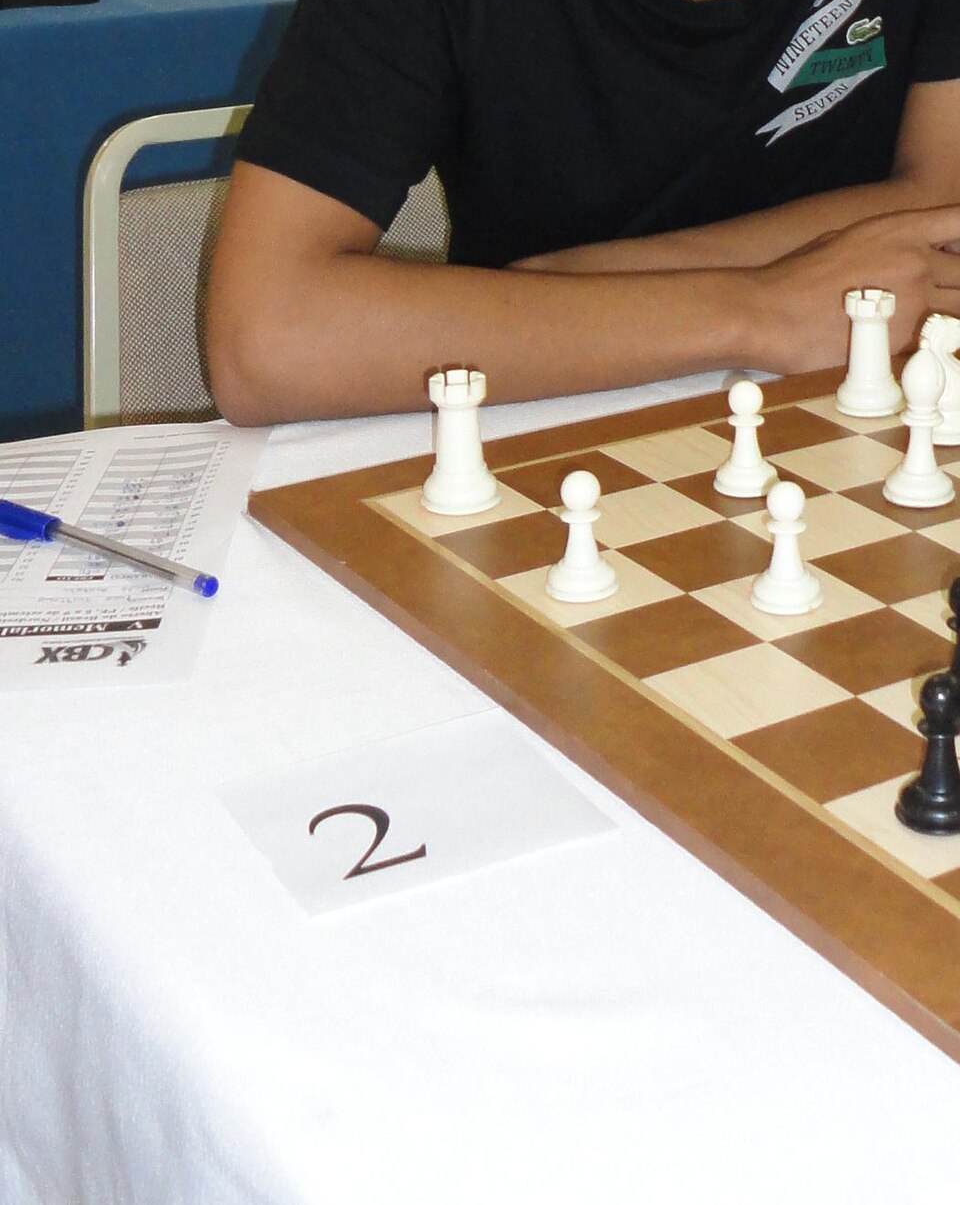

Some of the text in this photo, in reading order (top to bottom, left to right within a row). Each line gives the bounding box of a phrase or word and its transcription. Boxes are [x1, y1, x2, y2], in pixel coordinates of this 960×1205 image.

[810, 47, 873, 76] TWENTY
[794, 82, 849, 122] SEVEN
[1, 622, 109, 636] Memorial
[33, 643, 115, 665] CBX
[308, 803, 427, 881] 2
